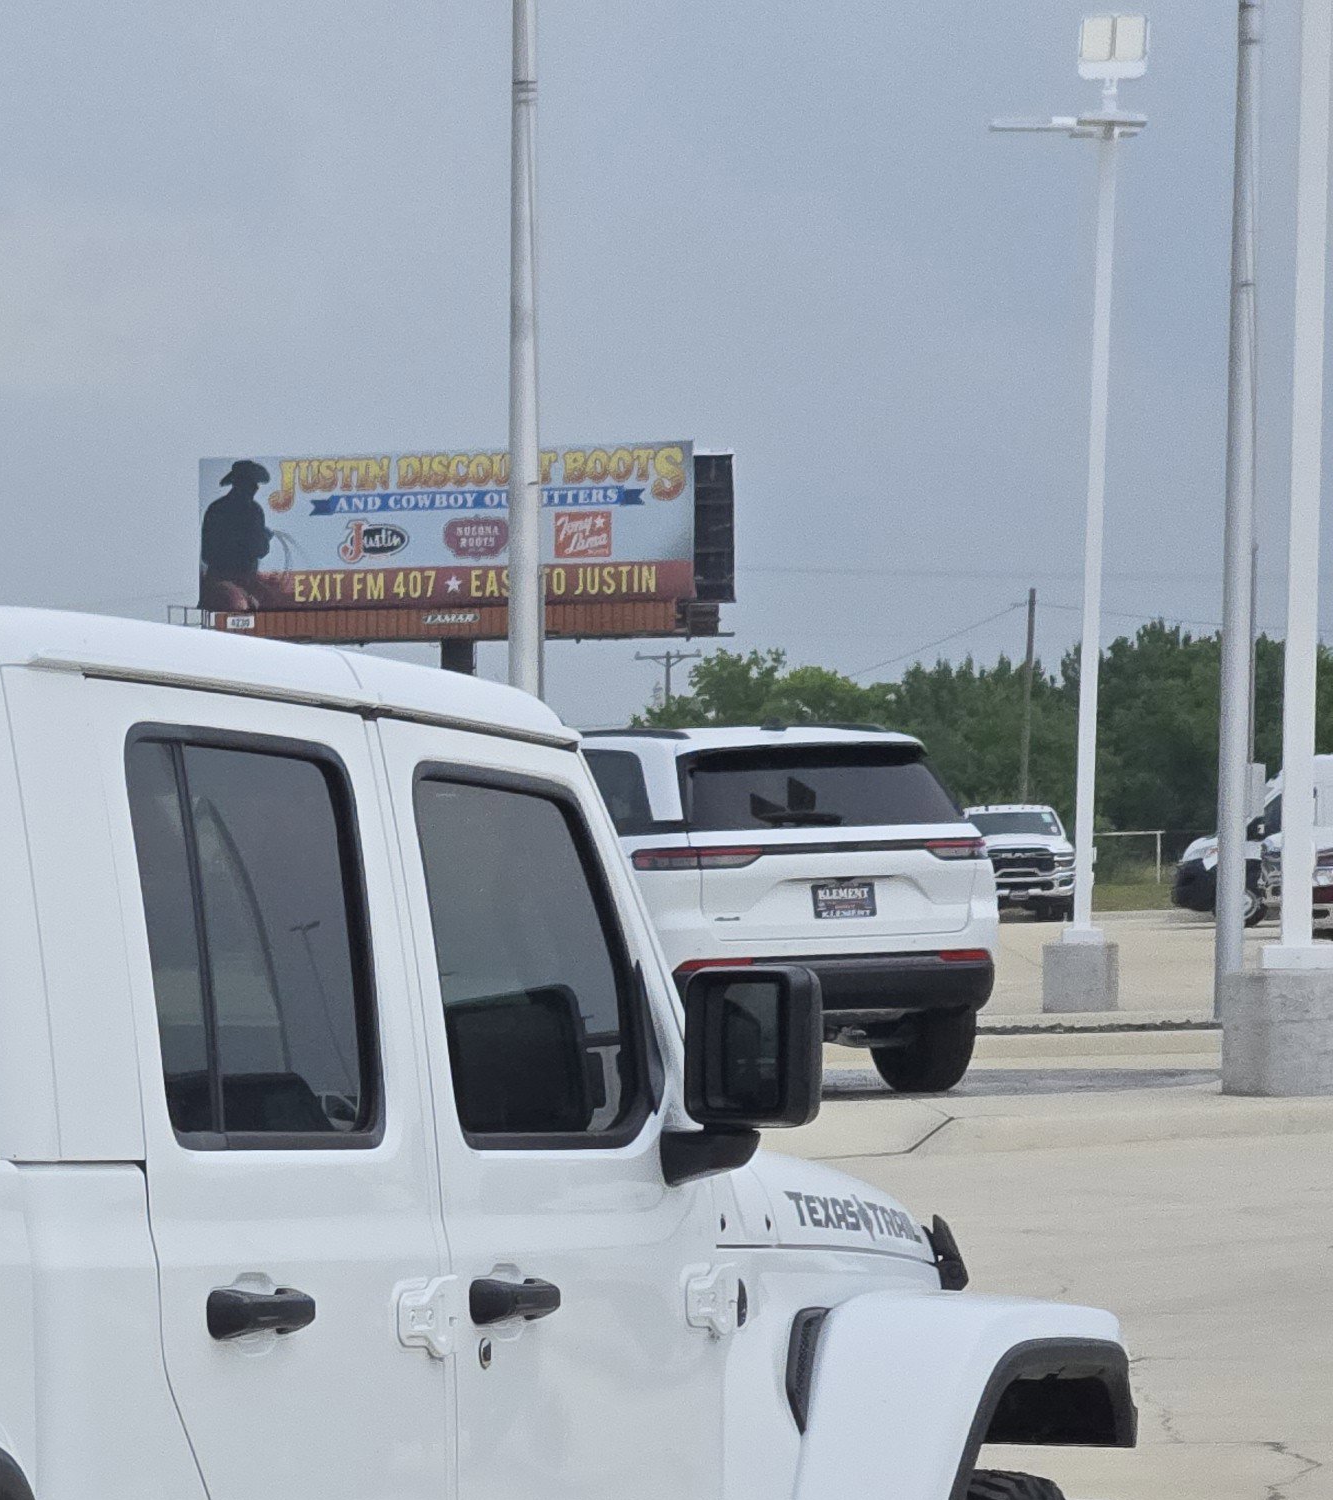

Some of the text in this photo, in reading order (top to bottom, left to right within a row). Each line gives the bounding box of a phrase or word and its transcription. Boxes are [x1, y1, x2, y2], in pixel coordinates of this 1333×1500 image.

[268, 447, 686, 512] JUSTIN DISCOUT BOOTS
[334, 496, 382, 512] AND
[388, 492, 478, 509] COWBOY
[294, 573, 345, 602] EXIT
[352, 572, 385, 600] FM
[393, 570, 437, 599] 407
[470, 568, 511, 598] EAS
[573, 565, 657, 595] JUSTIN
[783, 1190, 862, 1231] TEXAS
